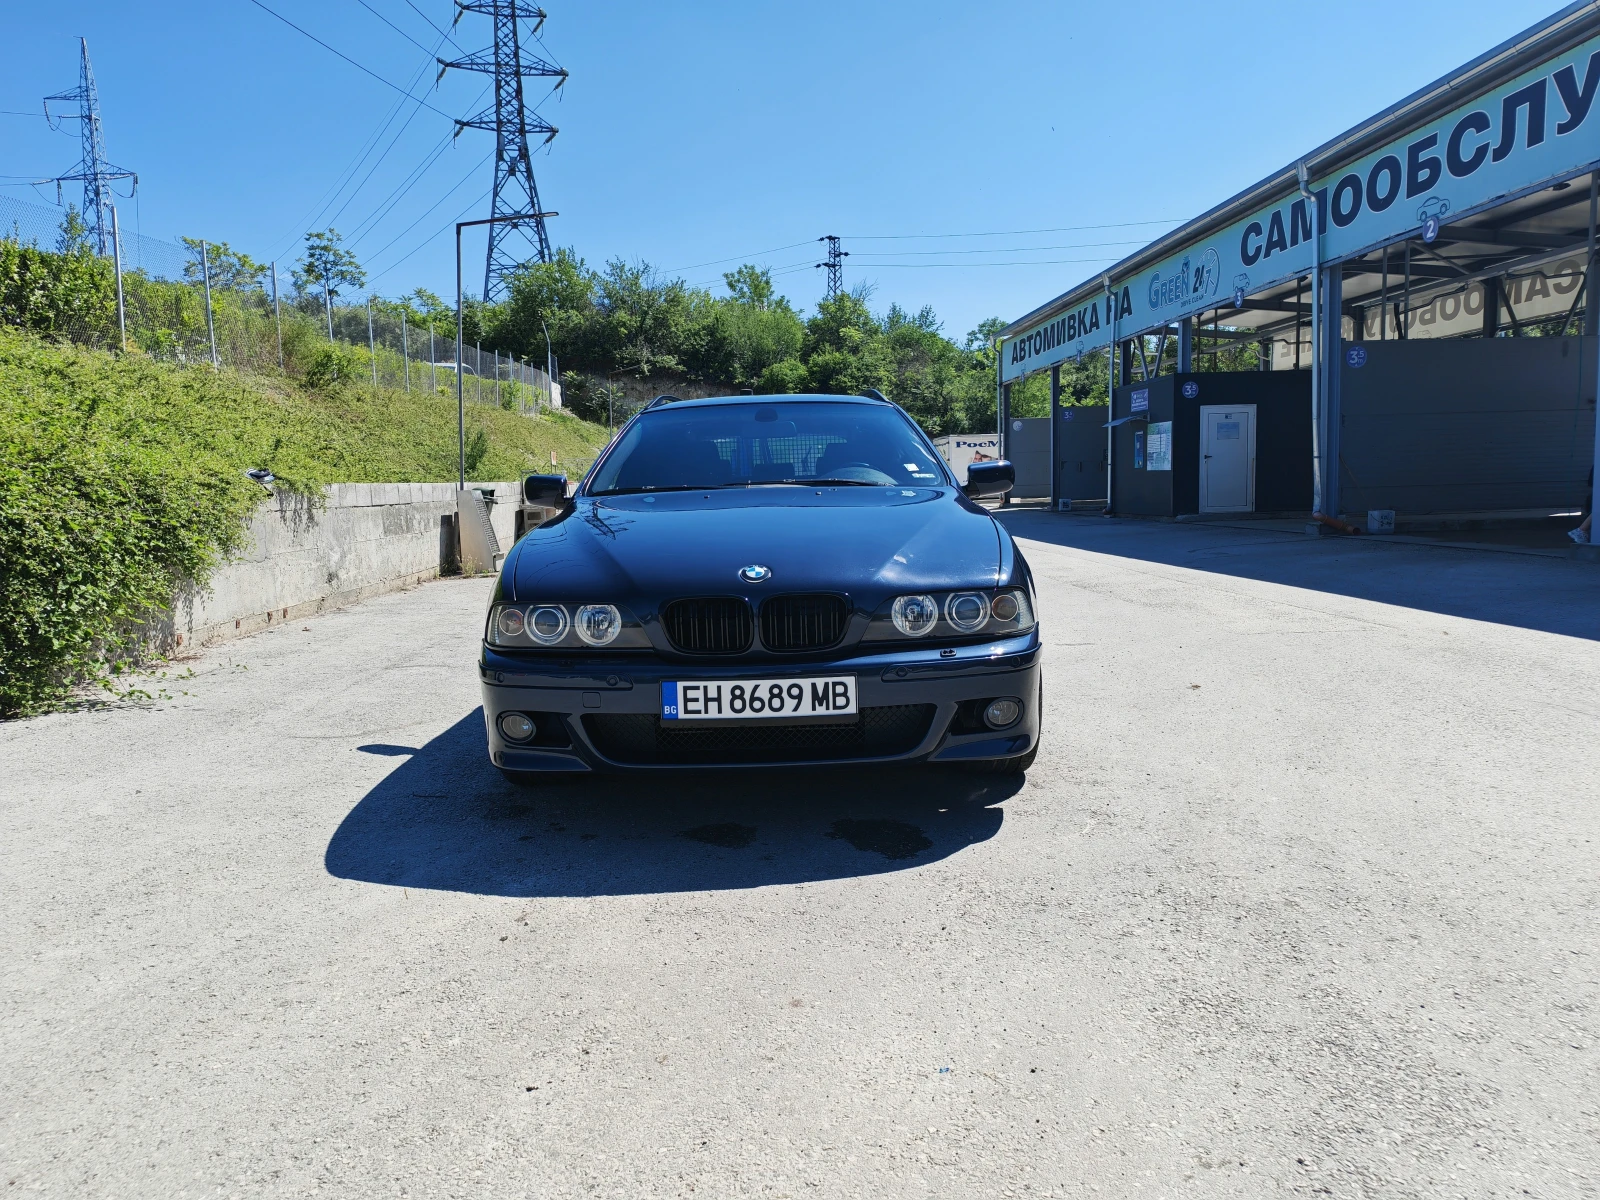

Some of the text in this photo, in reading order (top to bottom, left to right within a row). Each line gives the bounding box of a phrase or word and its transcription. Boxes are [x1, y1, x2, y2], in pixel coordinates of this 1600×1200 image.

[1426, 219, 1435, 238] 2
[1148, 271, 1190, 311] GREEN
[1236, 292, 1242, 305] 3
[1011, 302, 1100, 365] АВТОМИВКА
[1106, 285, 1133, 326] НА
[664, 705, 677, 715] BG
[682, 681, 851, 715] EH 8689 MB
